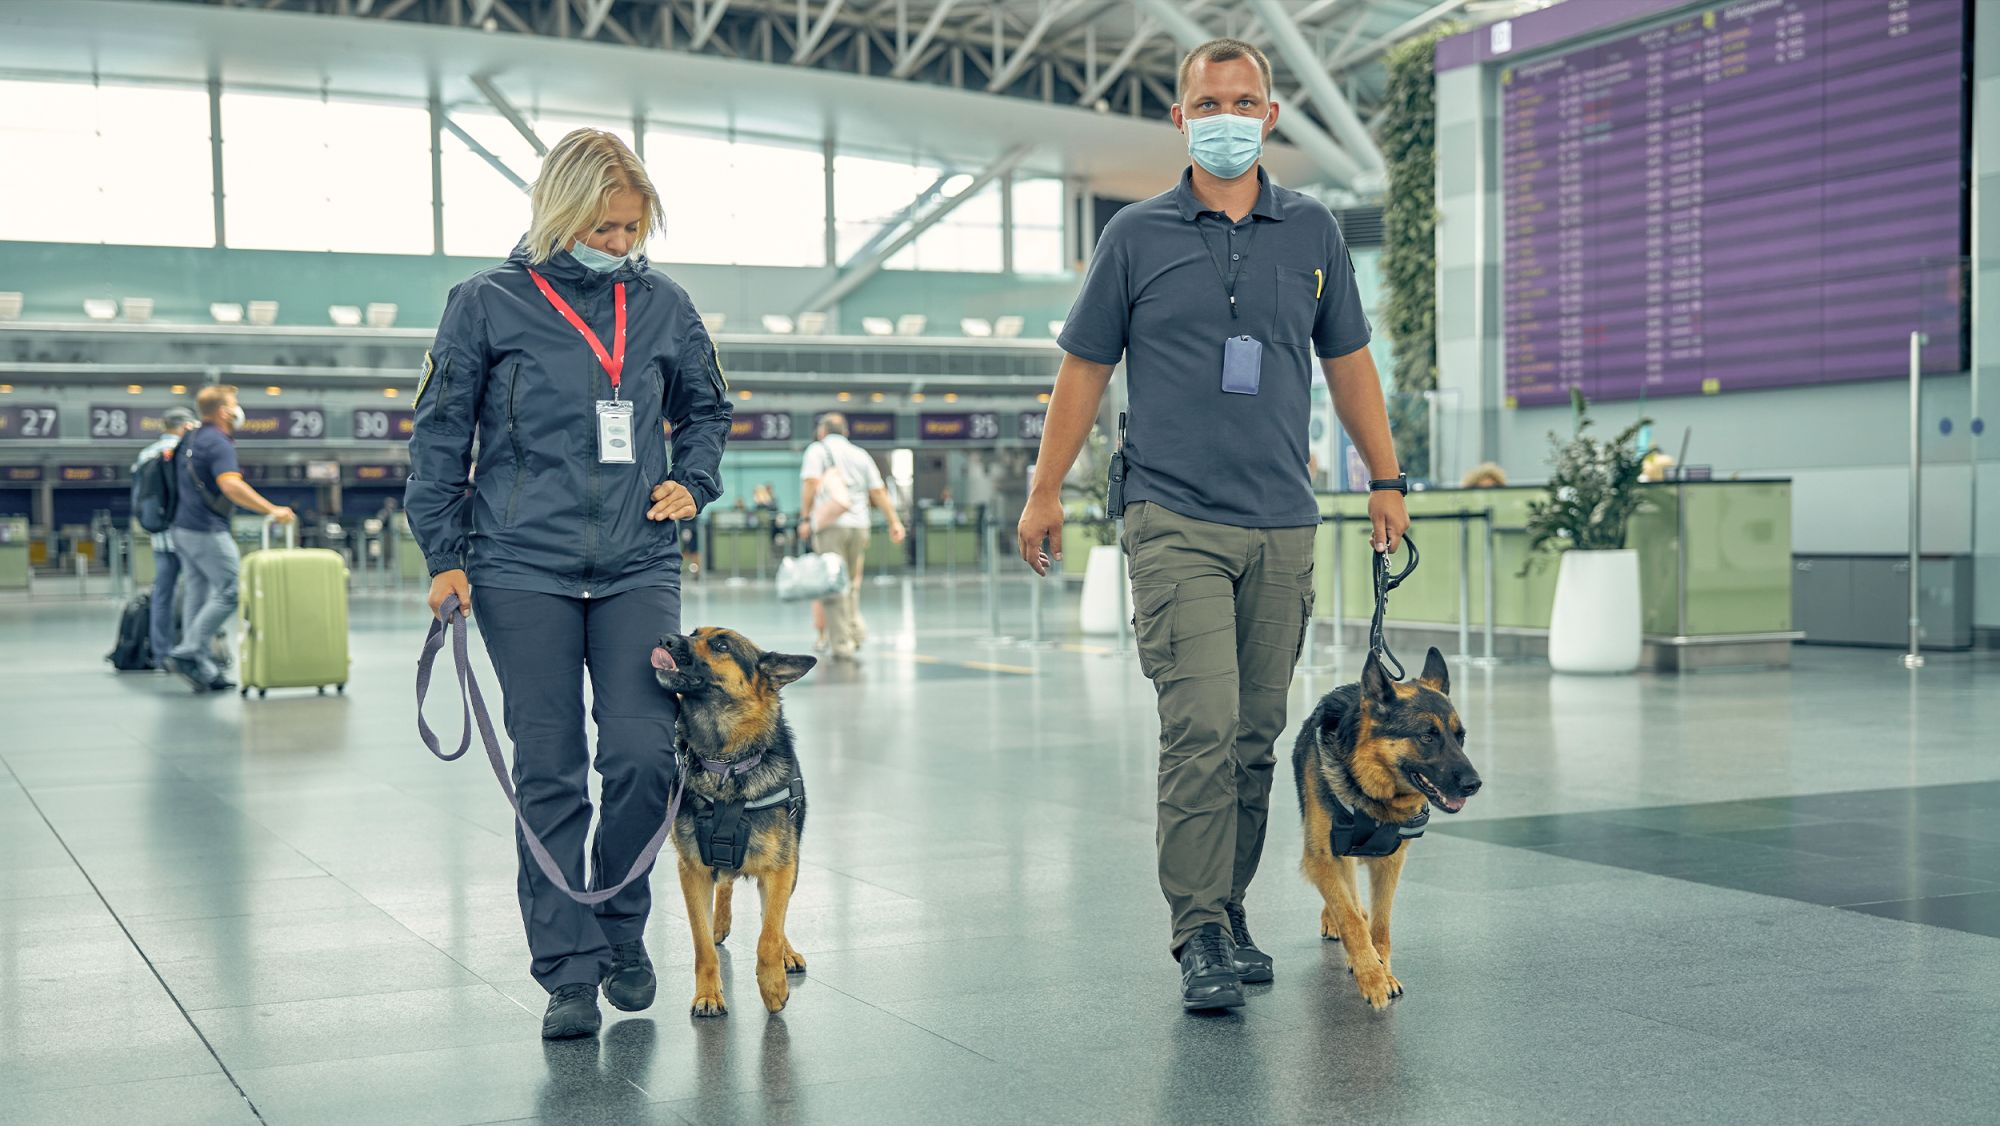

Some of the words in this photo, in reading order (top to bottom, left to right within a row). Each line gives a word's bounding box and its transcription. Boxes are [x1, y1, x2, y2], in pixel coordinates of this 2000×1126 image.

[20, 408, 57, 437] 27
[92, 409, 128, 437] 28
[288, 410, 324, 438] 29
[354, 411, 389, 438] 30
[760, 413, 792, 440] 33
[969, 413, 999, 439] 35
